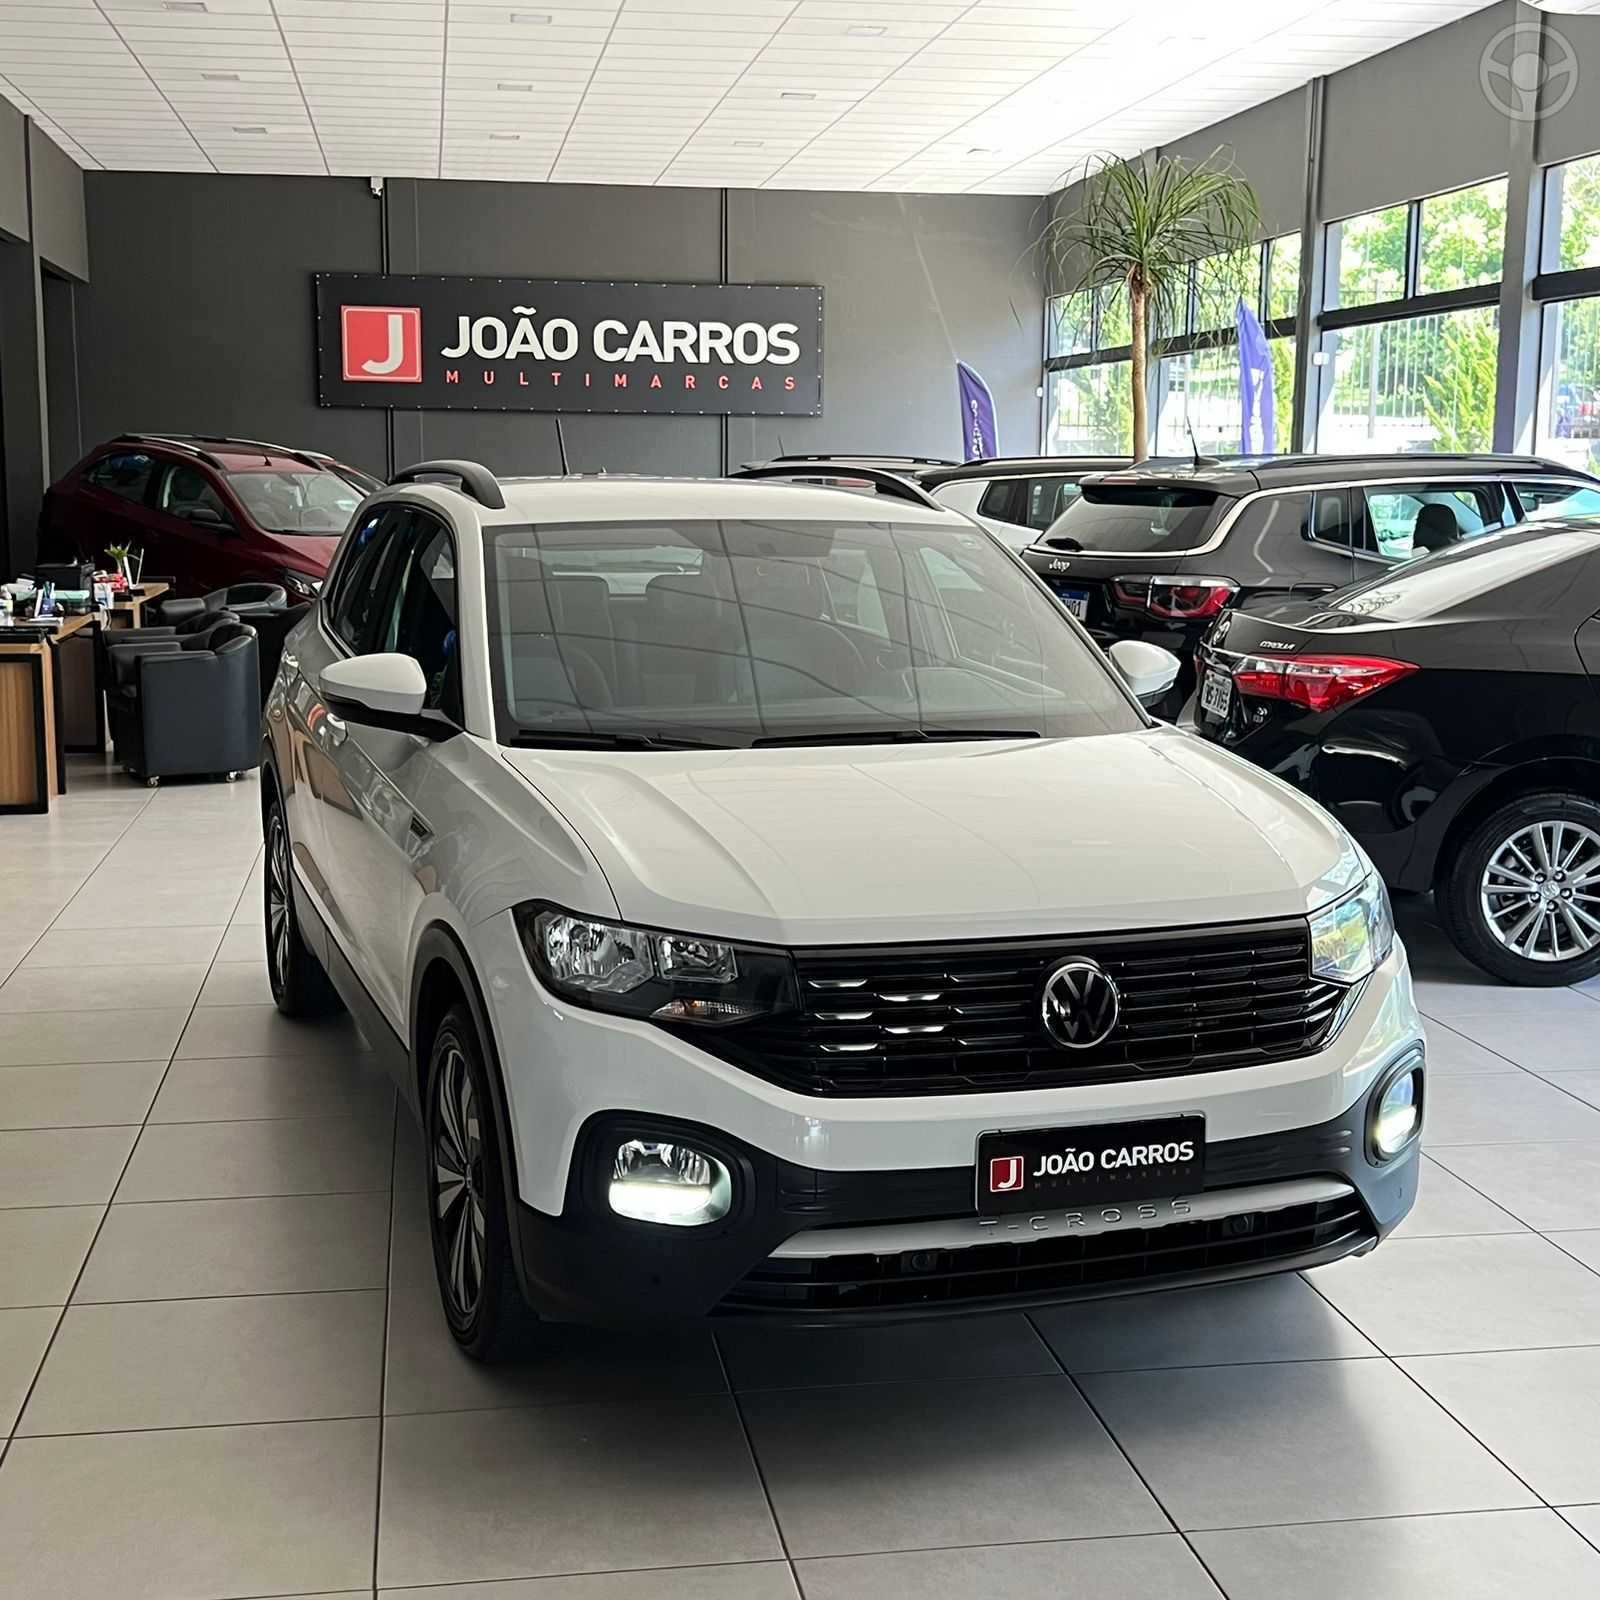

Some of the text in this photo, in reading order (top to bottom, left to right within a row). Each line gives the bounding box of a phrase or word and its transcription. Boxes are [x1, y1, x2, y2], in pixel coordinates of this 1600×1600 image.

[361, 314, 404, 375] J
[441, 306, 800, 365] JOÃO CARROS
[446, 370, 796, 390] MULTIMARCAS
[998, 1158, 1017, 1189] J
[1033, 1141, 1194, 1176] JOÃO CARROS
[979, 1200, 1191, 1234] T-CROSS
